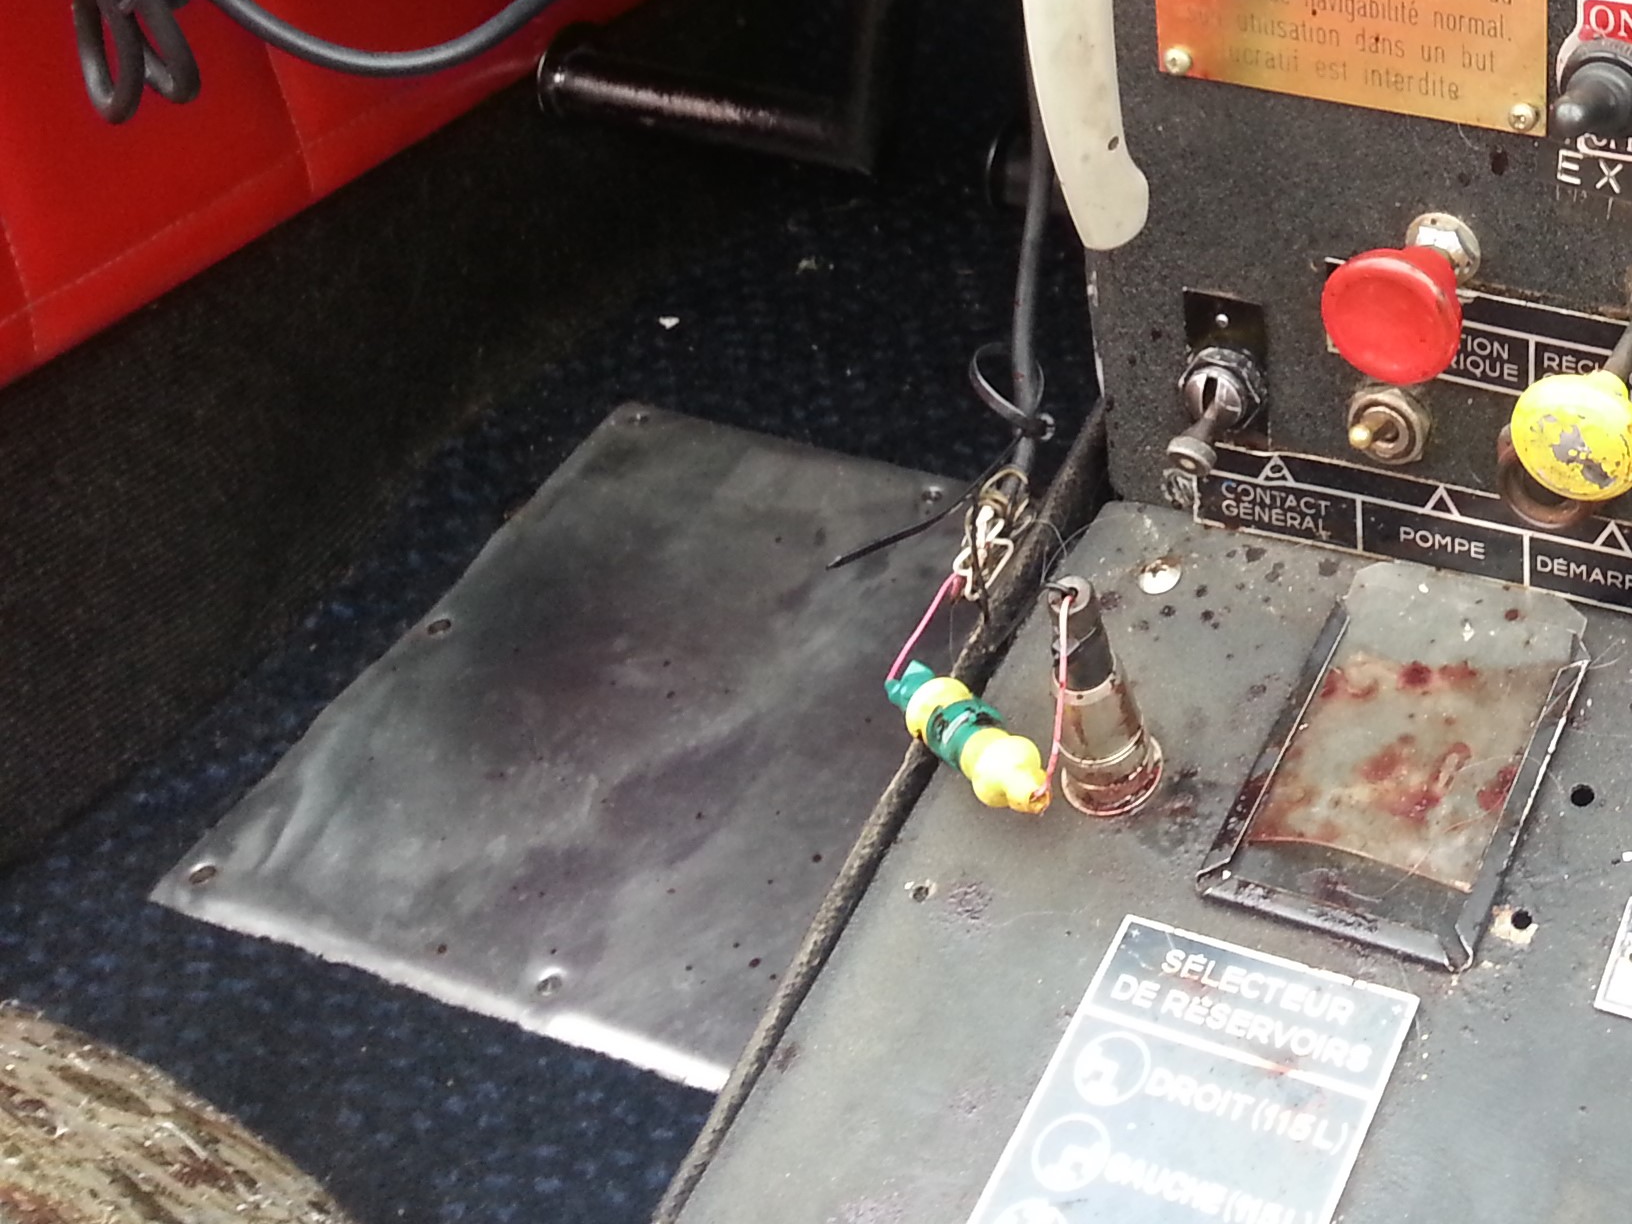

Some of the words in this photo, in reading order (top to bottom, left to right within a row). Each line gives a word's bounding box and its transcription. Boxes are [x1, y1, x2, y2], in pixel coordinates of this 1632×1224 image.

[1432, 9, 1513, 43] normal.
[1355, 26, 1405, 58] dans
[1420, 42, 1446, 64] un
[1462, 44, 1496, 74] but
[1364, 67, 1461, 102] interdite
[1221, 480, 1331, 516] CONTACT
[1399, 526, 1487, 561] POMPE
[1110, 973, 1157, 1010] DE
[1160, 948, 1356, 1027] SÉLECTEUR
[1144, 1066, 1258, 1127] DROIT
